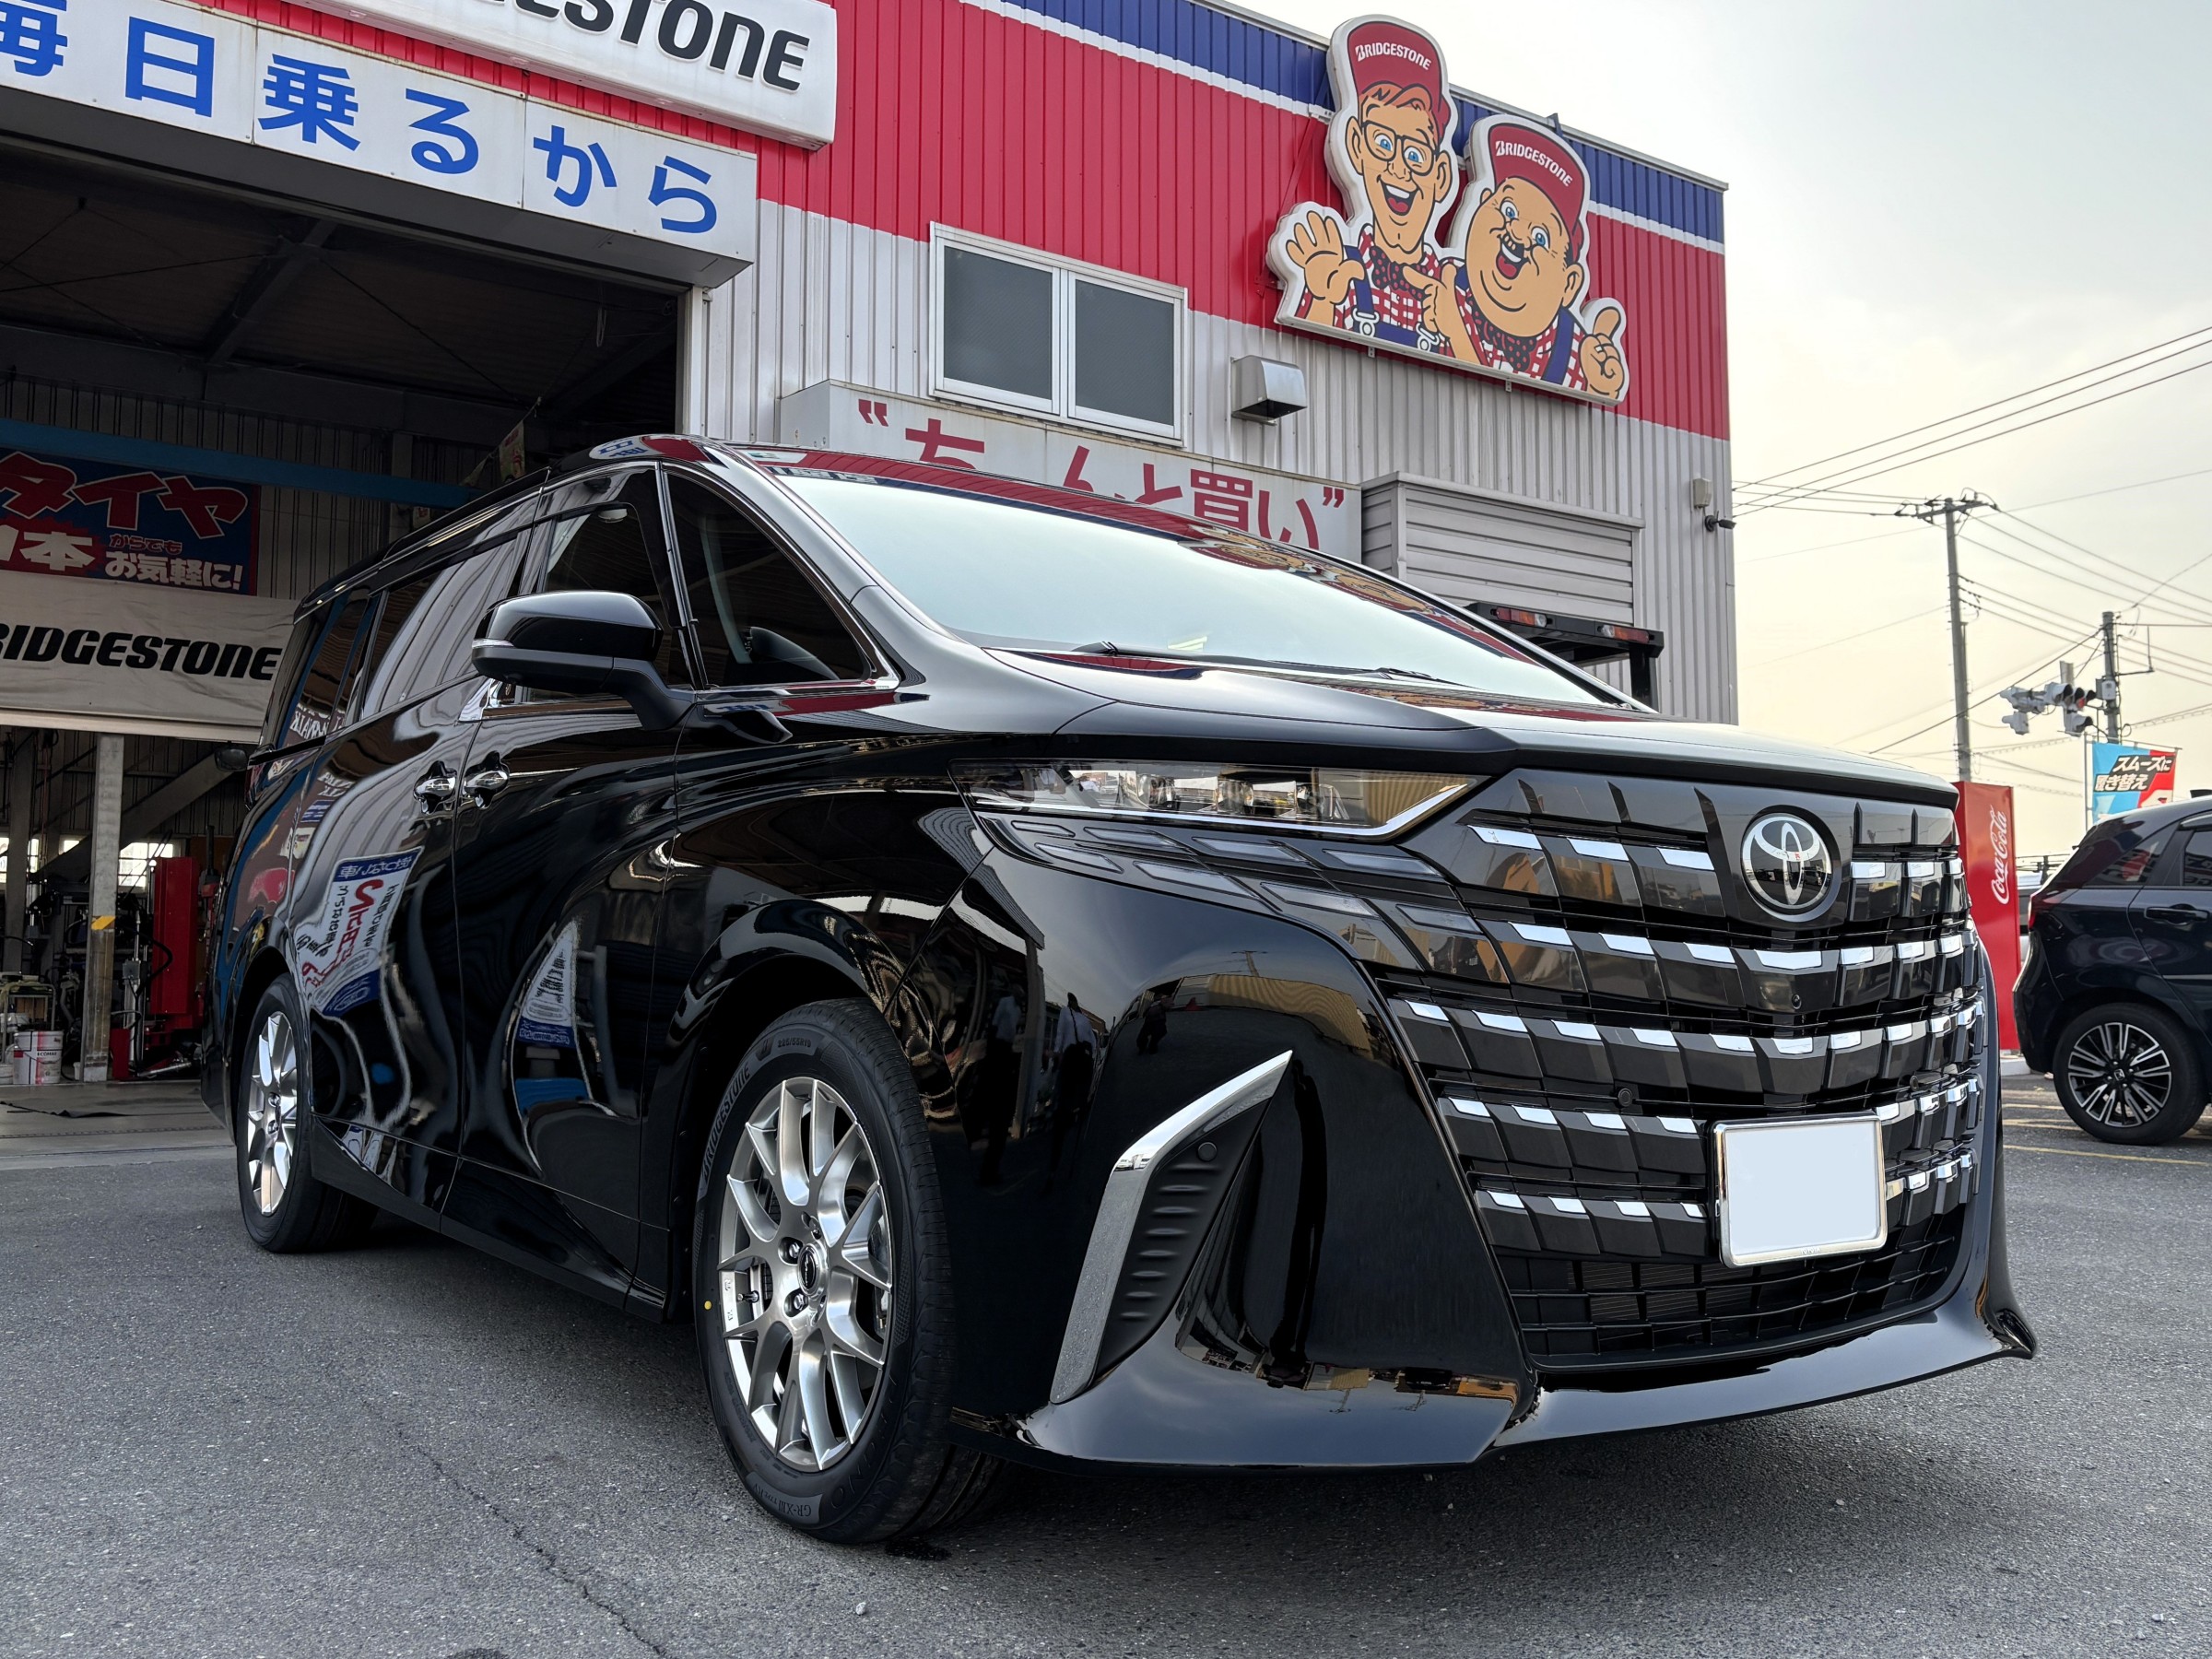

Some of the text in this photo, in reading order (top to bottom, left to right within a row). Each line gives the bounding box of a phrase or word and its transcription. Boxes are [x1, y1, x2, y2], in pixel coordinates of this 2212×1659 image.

[1355, 42, 1432, 71] BRIDGESTONE
[1496, 140, 1573, 187] BRIDGESTONE
[2112, 756, 2172, 772] スムーズに
[701, 1065, 750, 1183] BRIDGESTONE
